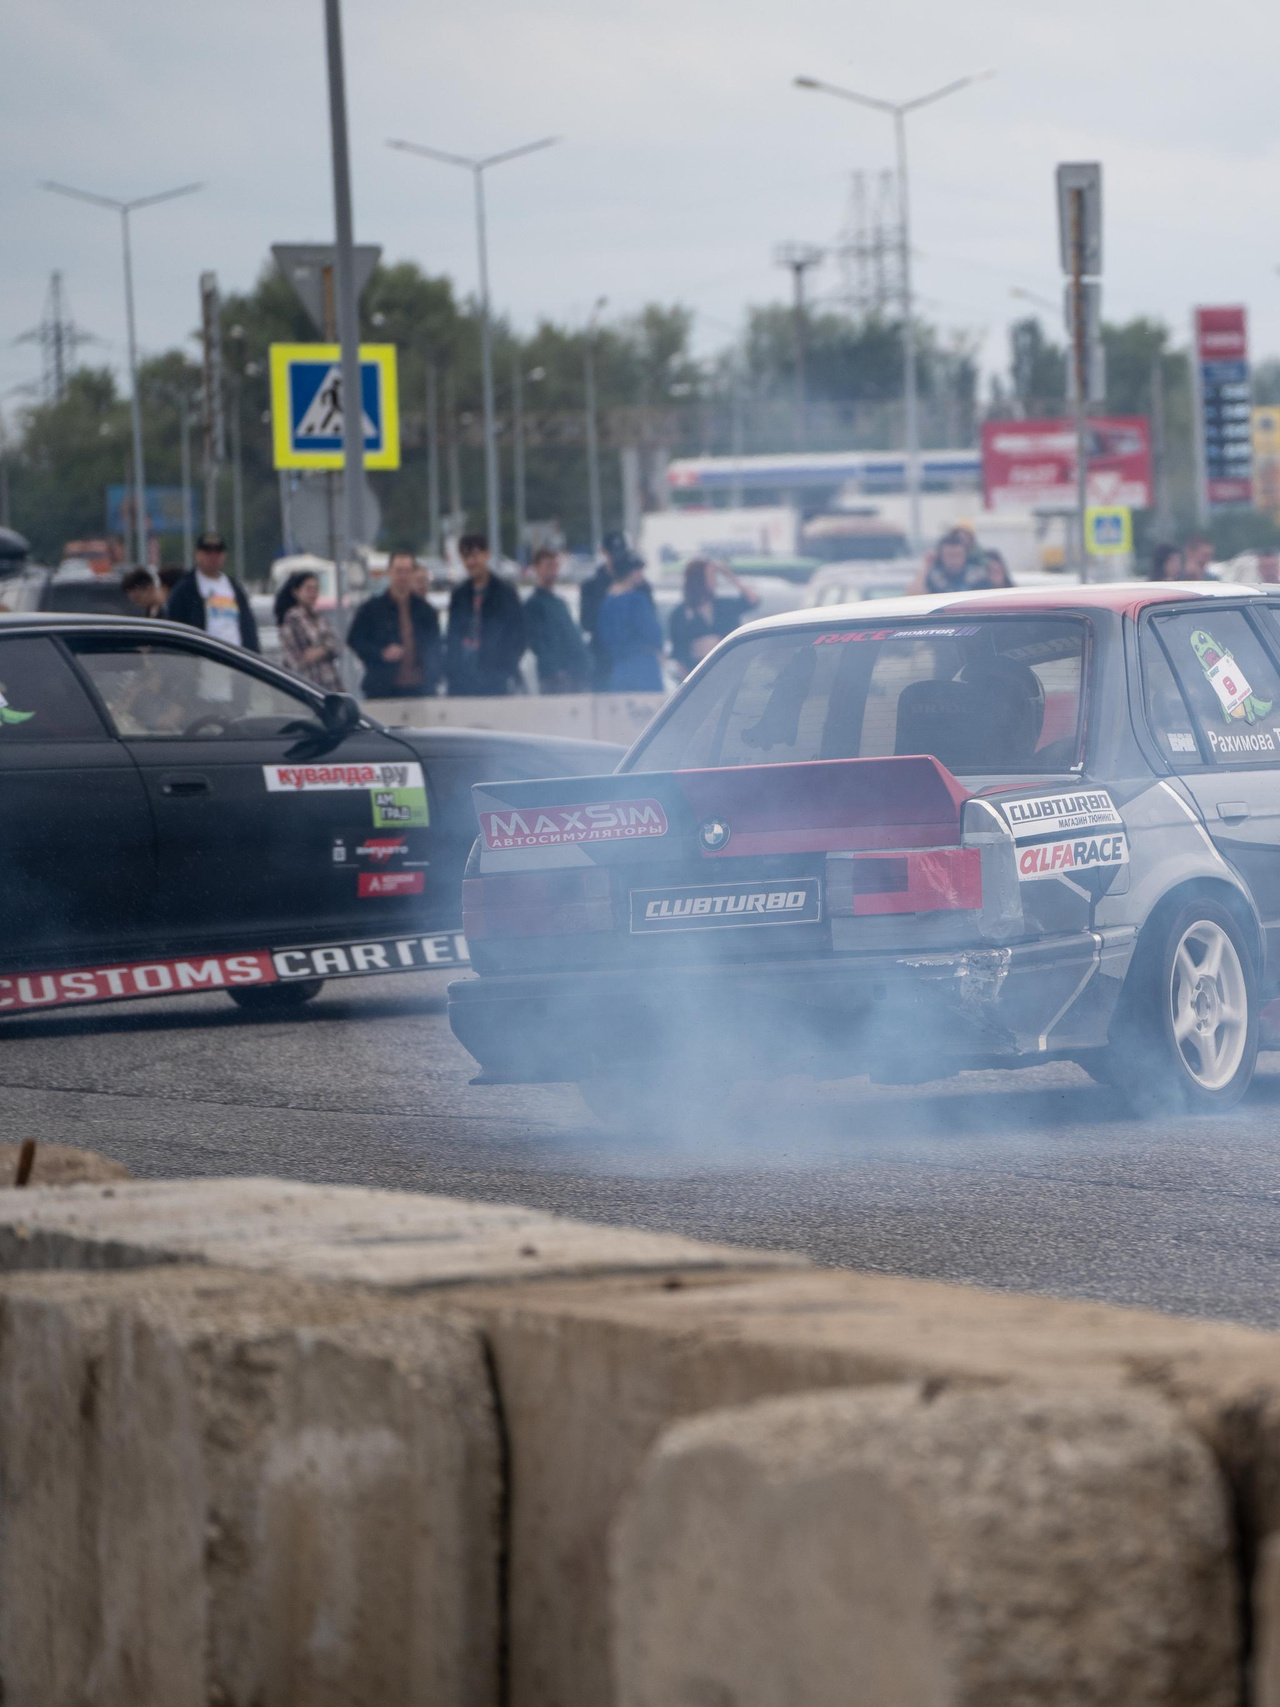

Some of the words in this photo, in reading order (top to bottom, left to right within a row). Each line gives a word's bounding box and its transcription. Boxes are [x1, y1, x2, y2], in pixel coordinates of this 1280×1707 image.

[813, 630, 894, 645] RACE
[893, 628, 956, 638] MONITOR
[1207, 730, 1275, 752] Рахимова
[277, 765, 409, 788] кувалда.ру
[1008, 794, 1112, 821] CLUBTURBO
[1058, 816, 1088, 829] МАГАЗИН
[492, 826, 663, 848] АВТОСИМУЛЯТОРЫ
[645, 890, 806, 918] CLUBTURBO
